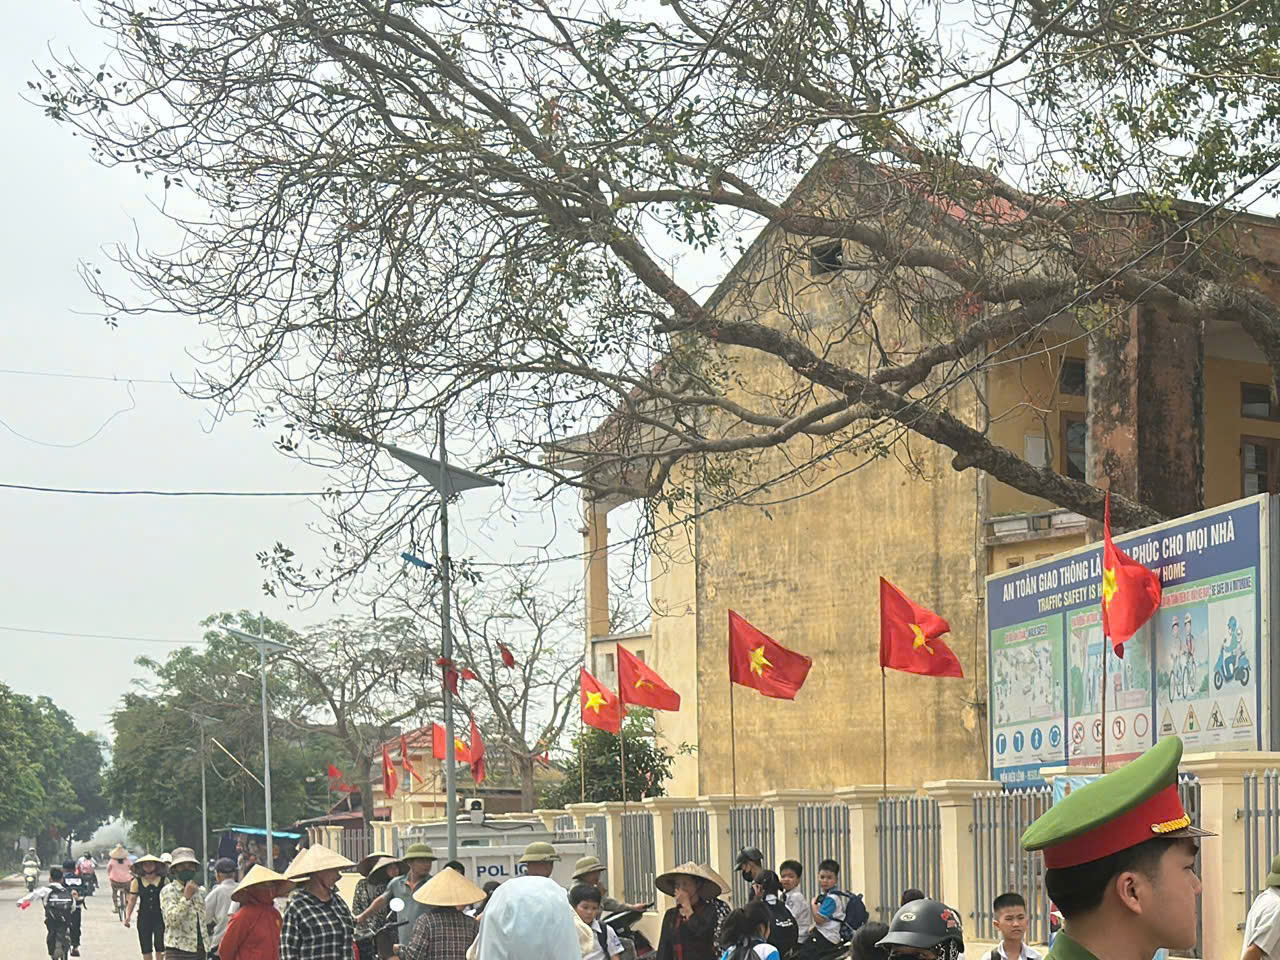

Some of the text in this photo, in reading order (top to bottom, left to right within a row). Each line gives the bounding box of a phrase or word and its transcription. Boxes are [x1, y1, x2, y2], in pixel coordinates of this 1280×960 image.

[1003, 582, 1014, 602] AN
[1015, 573, 1037, 599] TOÀN
[1039, 569, 1057, 592] GIAO
[1060, 560, 1088, 587] THÔNG
[1090, 553, 1102, 578] LÀ
[1162, 534, 1183, 559] CHO
[1186, 527, 1207, 554] MỌI
[1210, 515, 1235, 546] NHÀ
[1038, 593, 1062, 613] TRAFFIC
[1063, 586, 1087, 606] SAFETY
[1088, 584, 1096, 600] IS
[1162, 561, 1186, 582] HOME
[476, 863, 528, 877] POLIC
